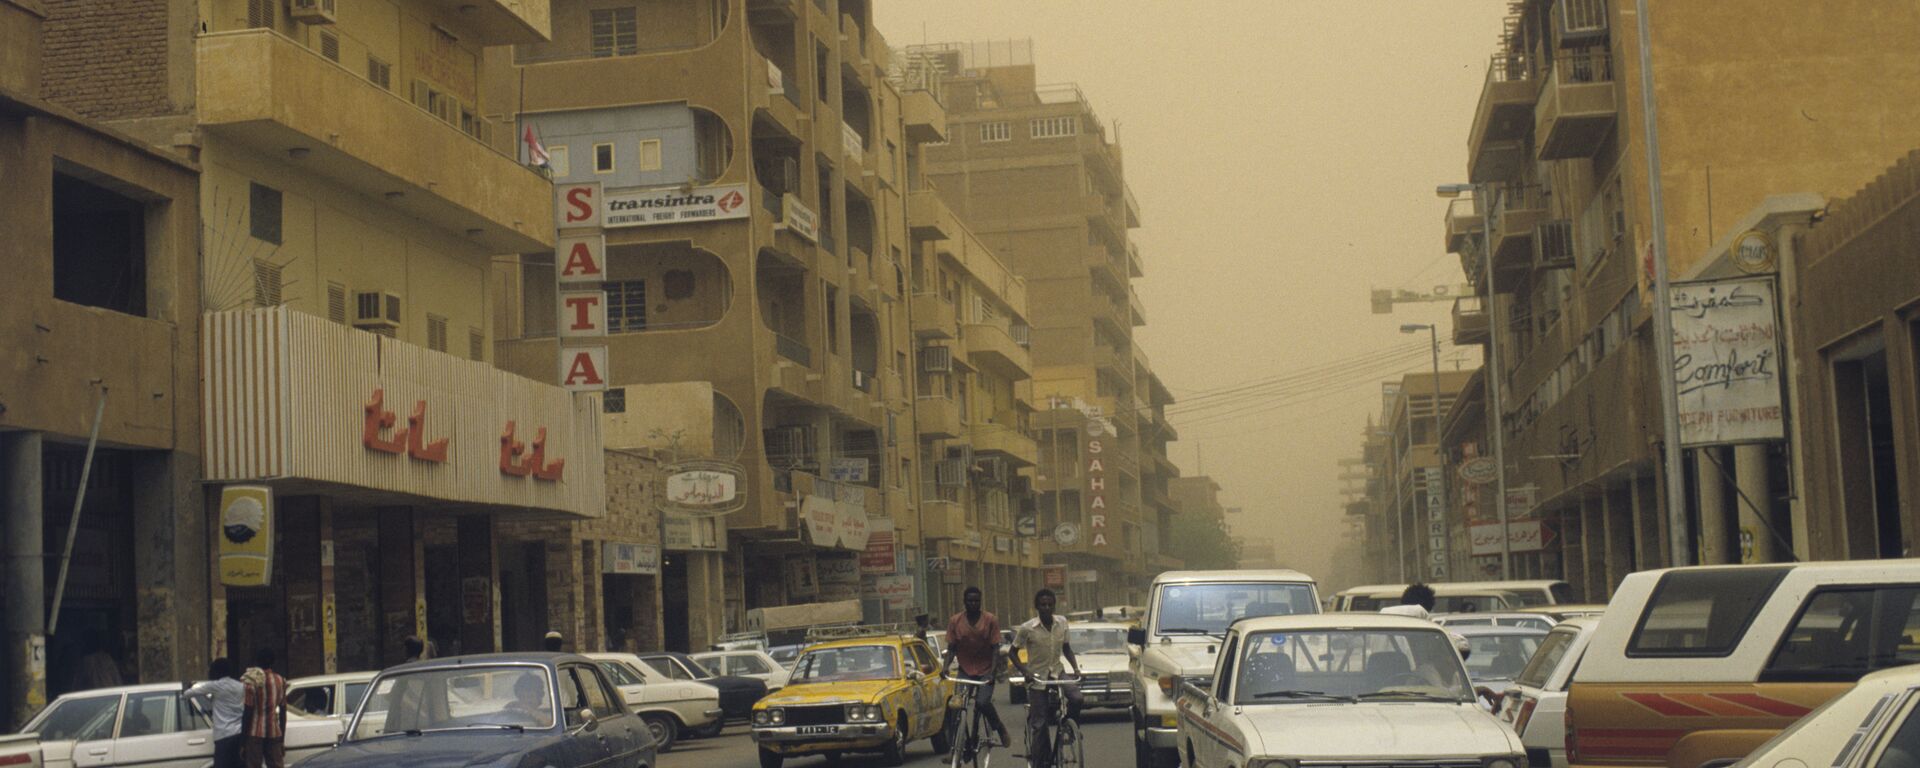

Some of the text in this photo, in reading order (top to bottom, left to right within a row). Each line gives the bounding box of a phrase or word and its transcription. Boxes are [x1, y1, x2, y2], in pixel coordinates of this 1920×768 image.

[607, 193, 715, 212] transintra
[607, 208, 716, 225] INTERNATIONAL FREIGHT FORWARDERS
[562, 187, 603, 385] SATA
[1674, 349, 1774, 390] Comfort
[363, 387, 565, 481] ساتا ساتا
[1088, 440, 1107, 546] SAHARA
[1430, 496, 1444, 577] AFRICA
